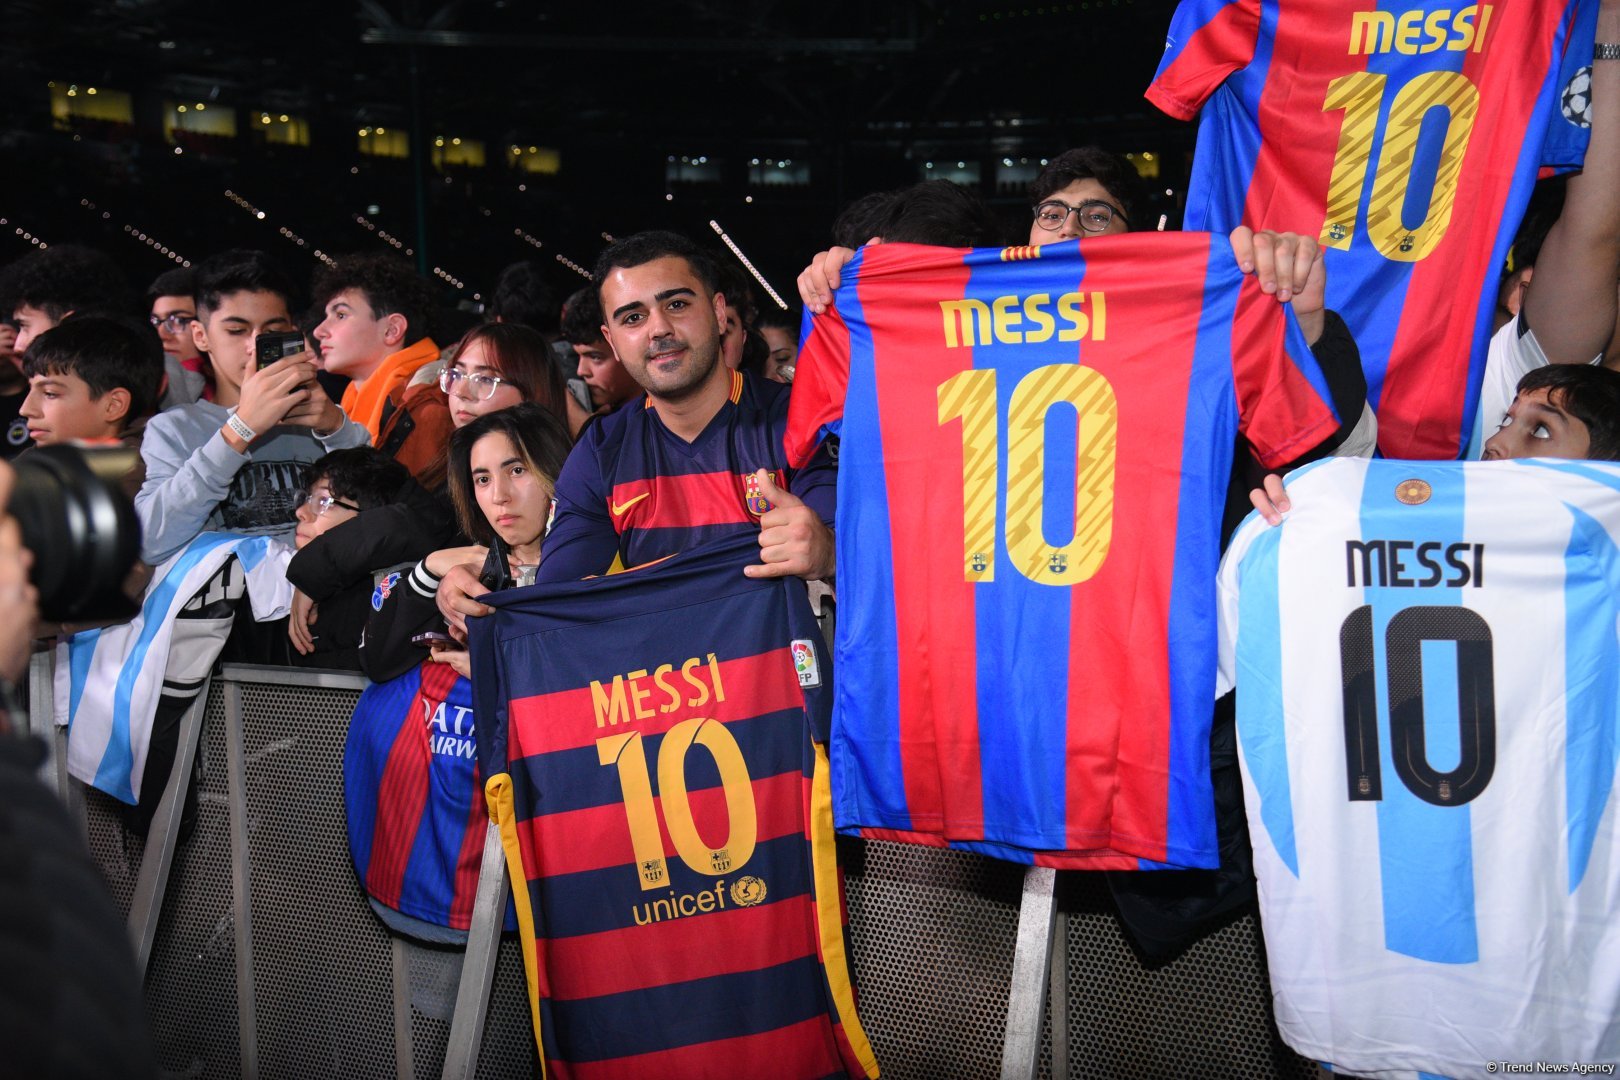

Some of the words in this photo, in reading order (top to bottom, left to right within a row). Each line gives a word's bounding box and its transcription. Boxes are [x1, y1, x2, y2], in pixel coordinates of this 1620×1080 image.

[1348, 4, 1494, 56] MESSI
[1319, 71, 1480, 262] 10
[939, 291, 1106, 348] MESSI
[937, 363, 1118, 586] 10
[1346, 539, 1485, 588] MESSI
[590, 652, 726, 728] MESSI
[799, 672, 812, 683] FP
[1339, 604, 1497, 807] 10
[429, 734, 478, 760] AIRW
[596, 717, 758, 891] 10
[632, 880, 726, 926] unicef
